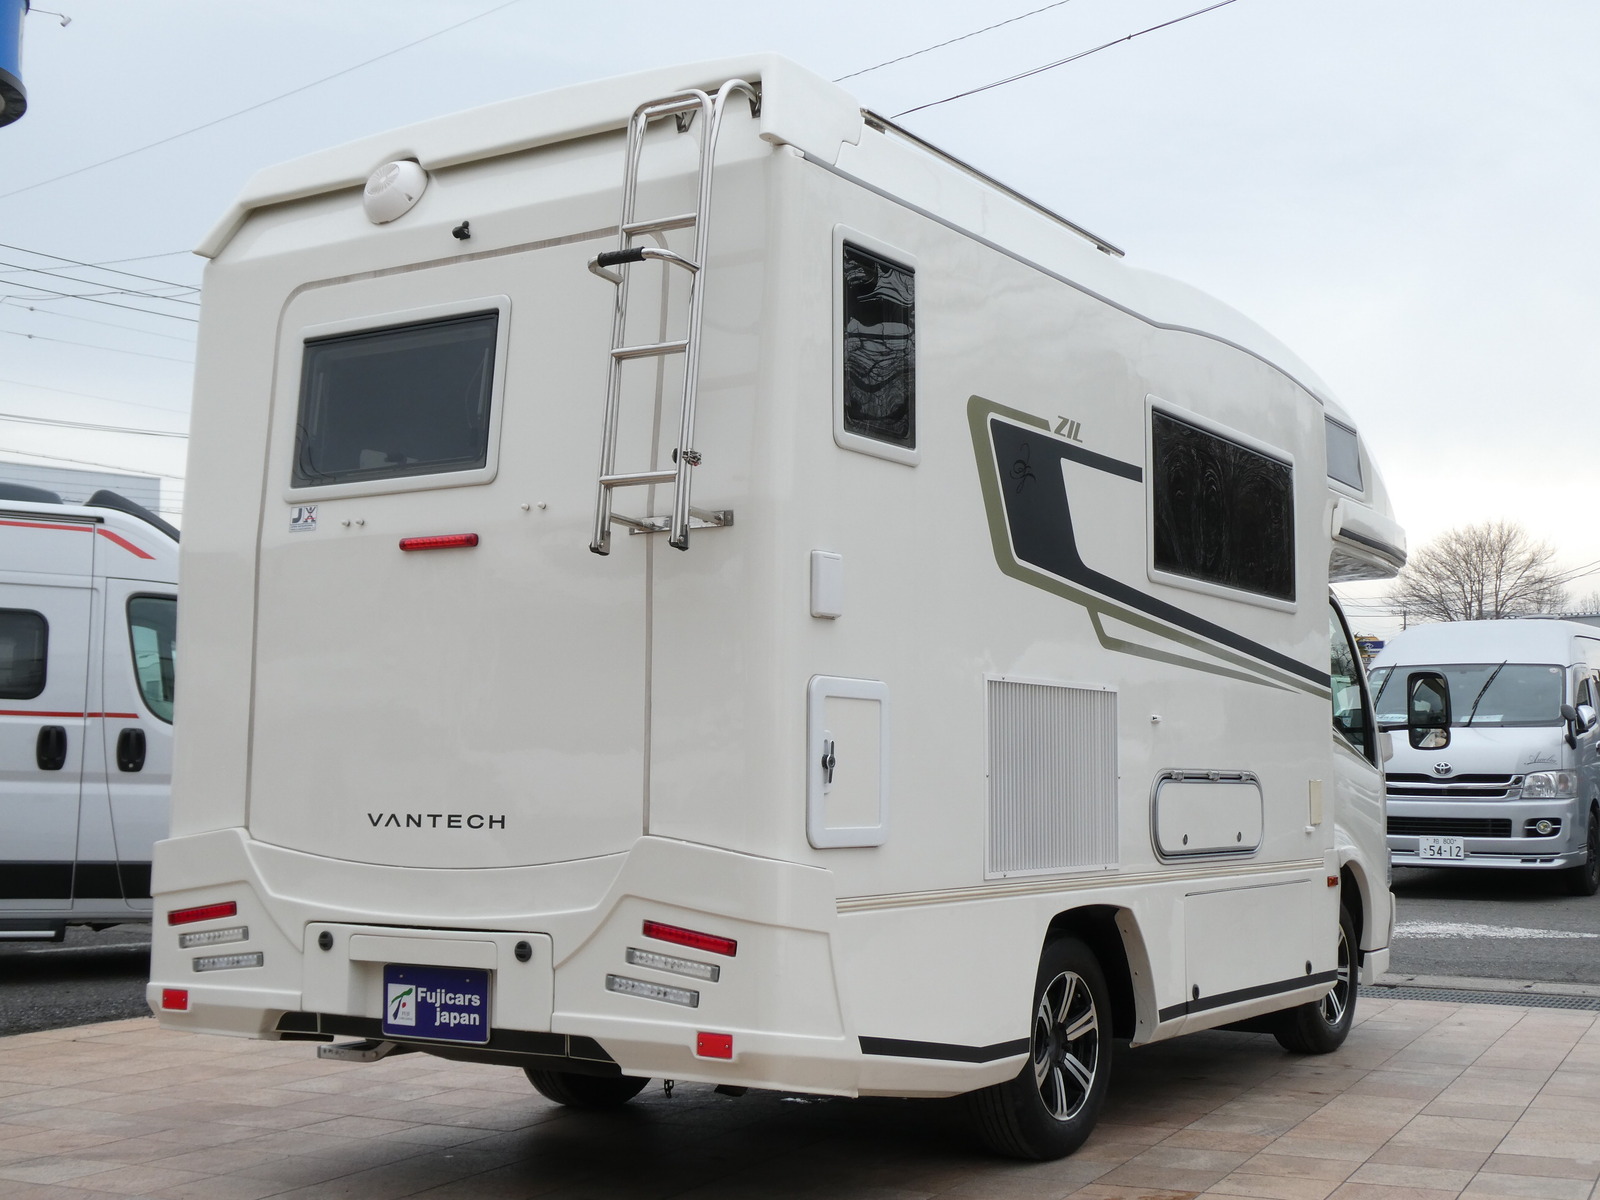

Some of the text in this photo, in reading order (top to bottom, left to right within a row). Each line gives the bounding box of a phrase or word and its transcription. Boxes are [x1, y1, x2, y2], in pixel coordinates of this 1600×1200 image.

[1054, 415, 1083, 443] ZIL
[367, 813, 506, 829] VANTECH
[1429, 845, 1462, 858] 54-12
[417, 987, 481, 1007] Fujicars
[435, 1007, 480, 1027] japan
